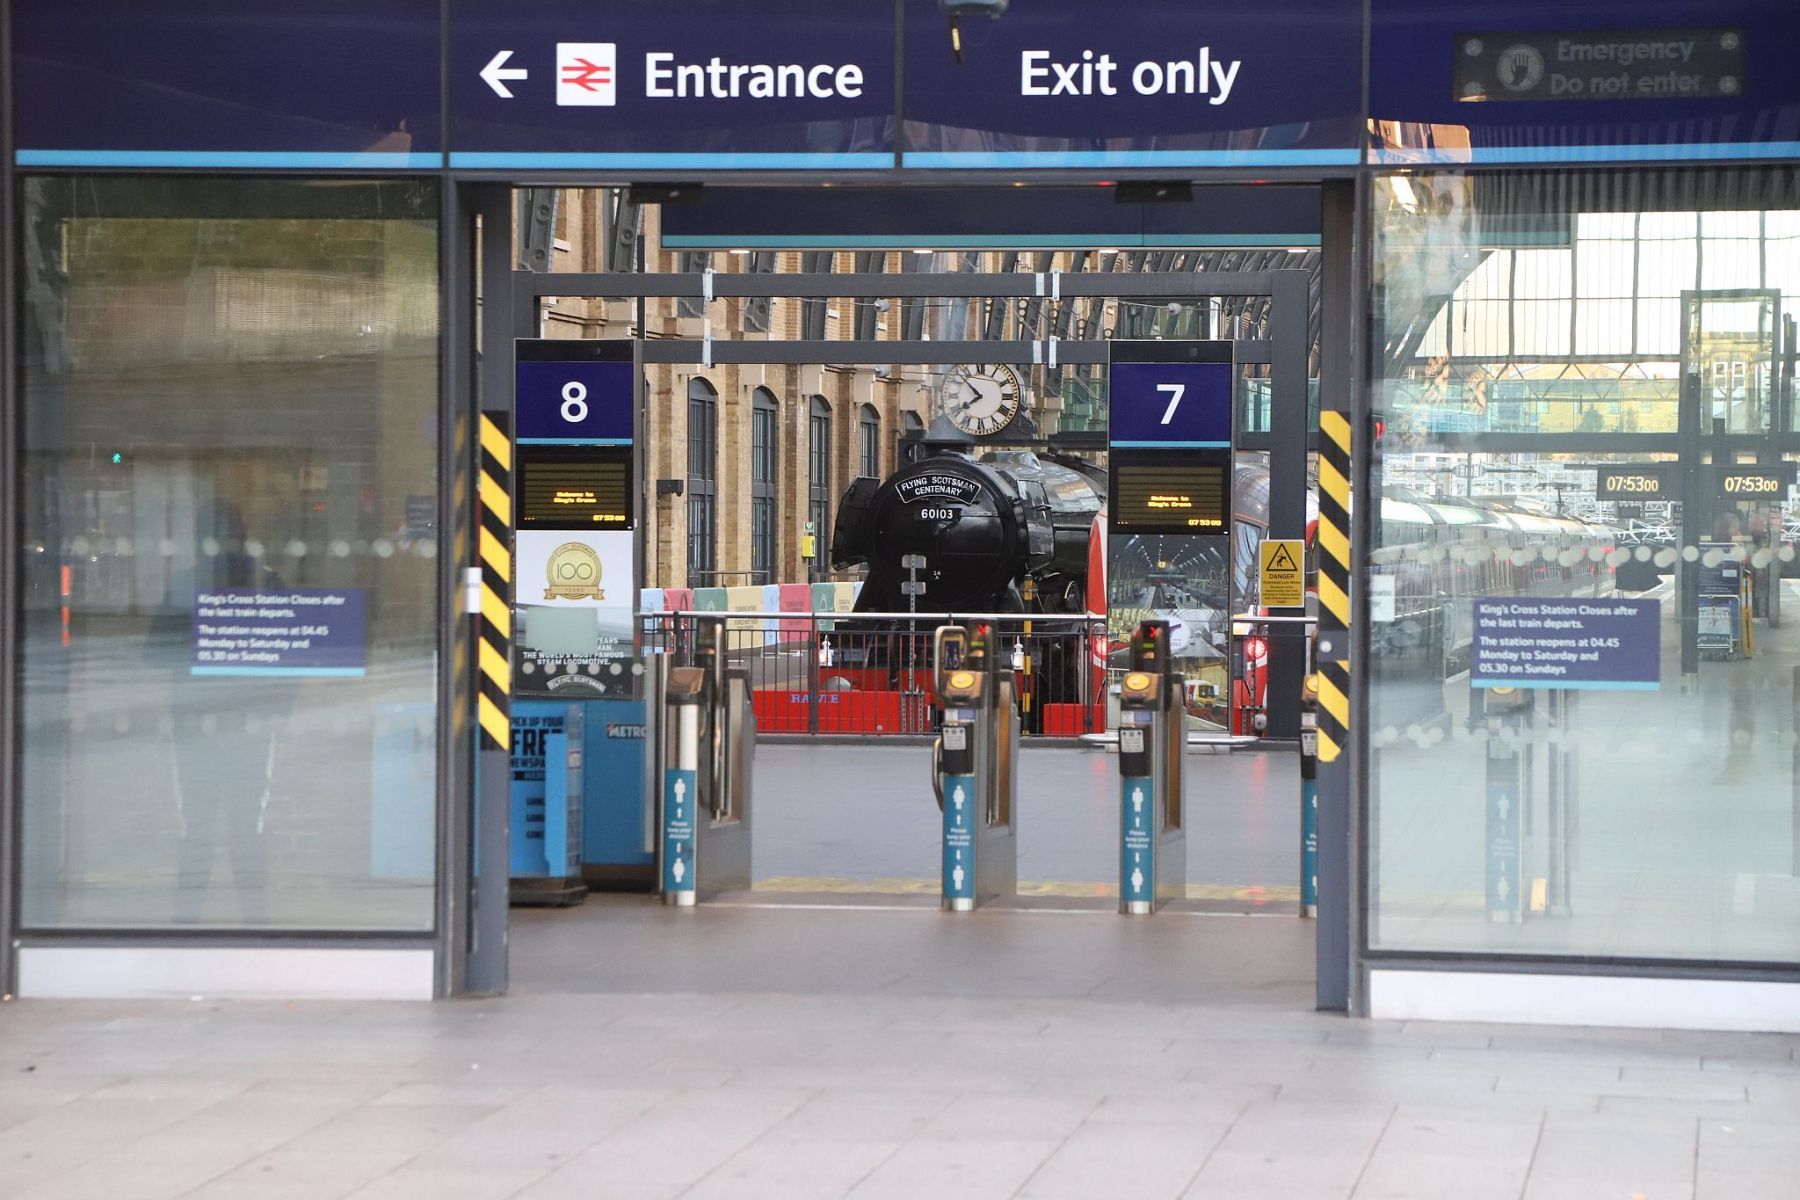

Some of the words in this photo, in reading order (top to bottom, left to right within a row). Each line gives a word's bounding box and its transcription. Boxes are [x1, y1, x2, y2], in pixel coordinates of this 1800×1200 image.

[1557, 40, 1694, 66] Emergency
[645, 52, 863, 98] Entrance
[1021, 50, 1117, 96] Exit
[1132, 47, 1241, 105] only
[1550, 74, 1584, 95] Do
[1590, 72, 1631, 94] not
[1637, 71, 1704, 93] enter
[560, 381, 588, 423] 8
[1156, 384, 1185, 424] 7
[901, 477, 927, 491] FLYING
[931, 476, 975, 492] SCOTSMAN
[914, 485, 962, 496] CENTENARY
[921, 508, 954, 519] 60103
[557, 562, 593, 580] 100
[198, 594, 227, 606] King's
[227, 594, 254, 605] Cross
[255, 594, 290, 605] Station
[291, 594, 321, 605] Closes
[322, 595, 346, 606] after
[198, 608, 215, 617] the
[234, 608, 257, 617] train
[1480, 604, 1509, 616] King's
[1510, 605, 1539, 615] Cross
[1541, 605, 1577, 615] Station
[1578, 605, 1612, 616] Closes
[1613, 605, 1639, 616] after
[198, 625, 216, 635] The
[217, 625, 249, 635] station
[289, 627, 300, 635] at
[1480, 618, 1497, 628] the
[1498, 618, 1516, 628] last
[1518, 618, 1542, 628] train
[1543, 618, 1584, 630] departs.
[198, 638, 236, 650] Monday
[237, 639, 248, 648] to
[249, 639, 291, 650] Saturday
[291, 639, 310, 649] and
[1479, 636, 1498, 646] The
[1499, 636, 1535, 646] station
[1536, 638, 1577, 649] reopens
[1578, 638, 1588, 647] at
[1590, 637, 1620, 648] 04.45
[227, 653, 239, 661] on
[240, 652, 280, 663] Sundays
[1479, 650, 1519, 662] Monday
[1521, 651, 1533, 660] to
[1534, 650, 1578, 662] Saturday
[1579, 651, 1599, 661] and
[1479, 663, 1508, 673] 05.30
[1509, 665, 1523, 674] on
[1525, 664, 1566, 676] Sundays
